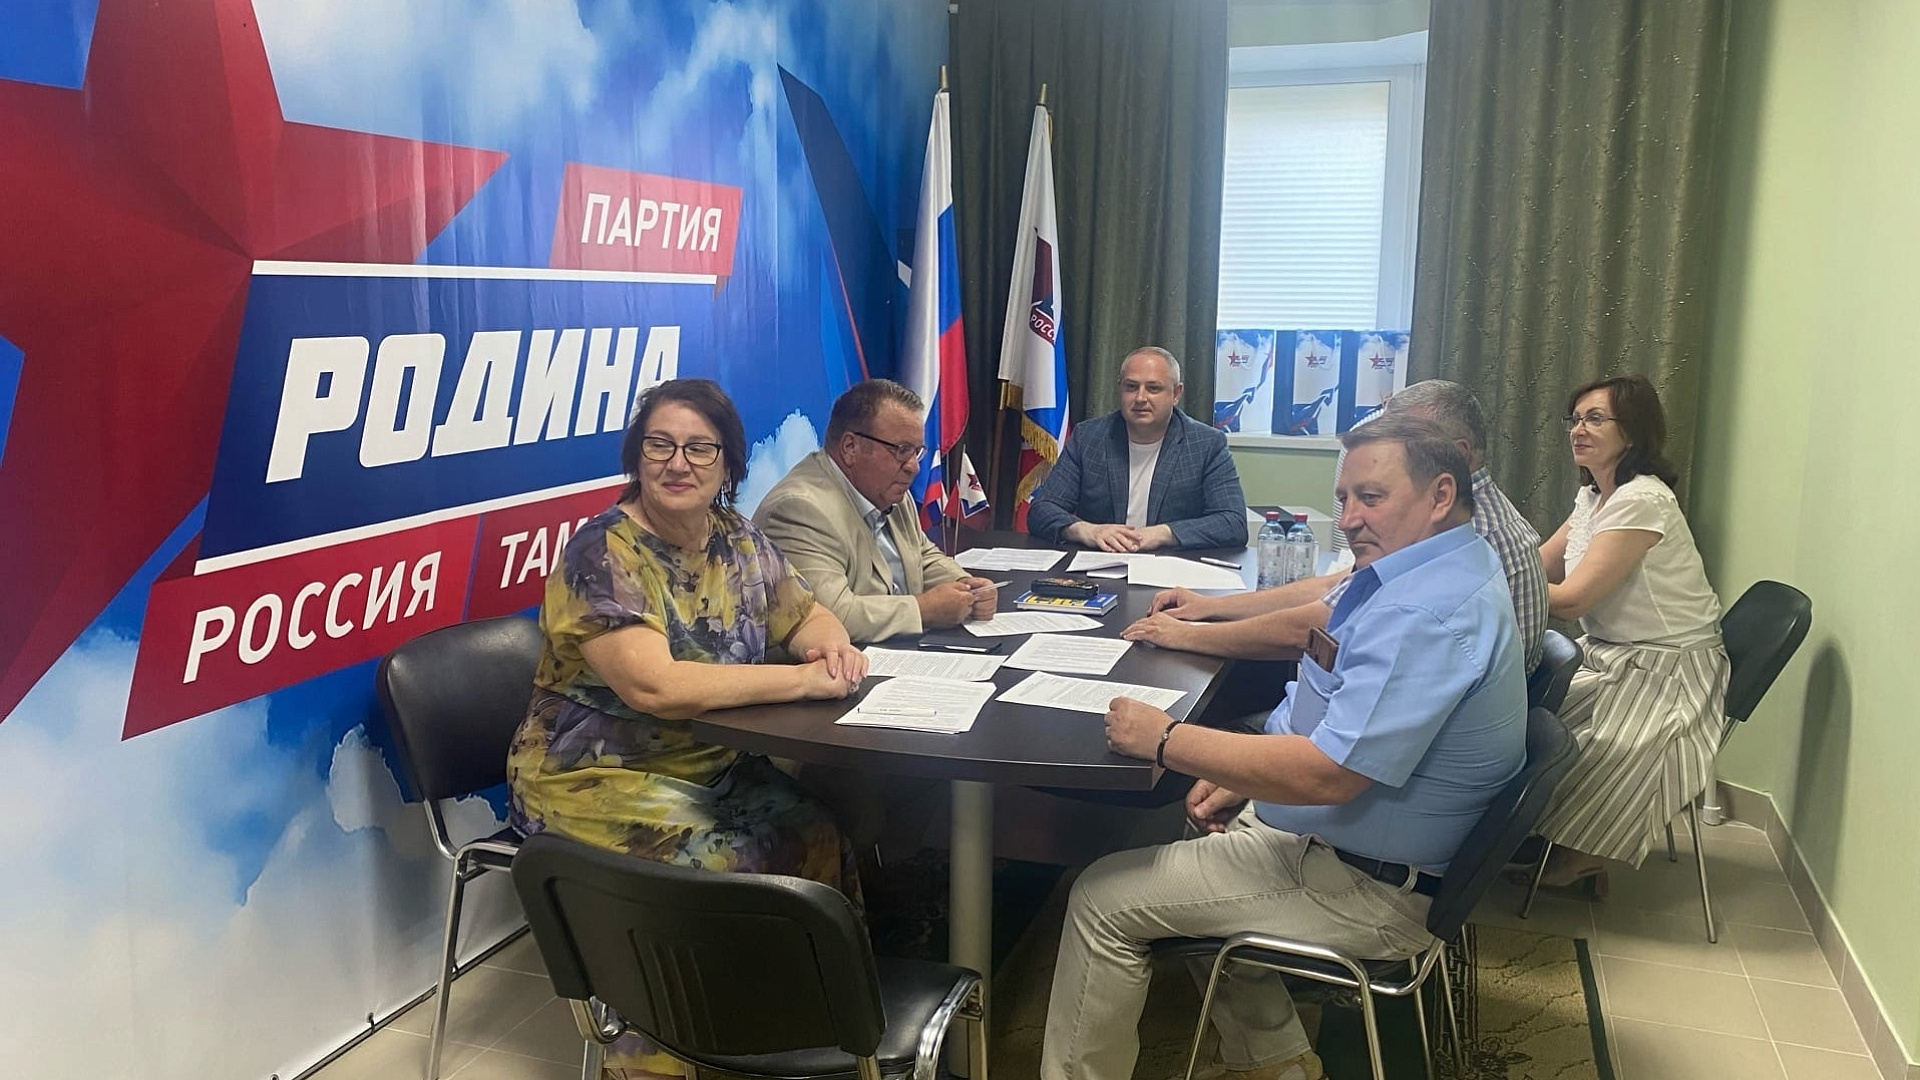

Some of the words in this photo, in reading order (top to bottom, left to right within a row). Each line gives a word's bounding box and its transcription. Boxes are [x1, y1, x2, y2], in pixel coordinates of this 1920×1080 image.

[581, 193, 722, 252] ПАРТИЯ
[1031, 314, 1054, 340] РОСС
[183, 552, 441, 683] РОССИЯ
